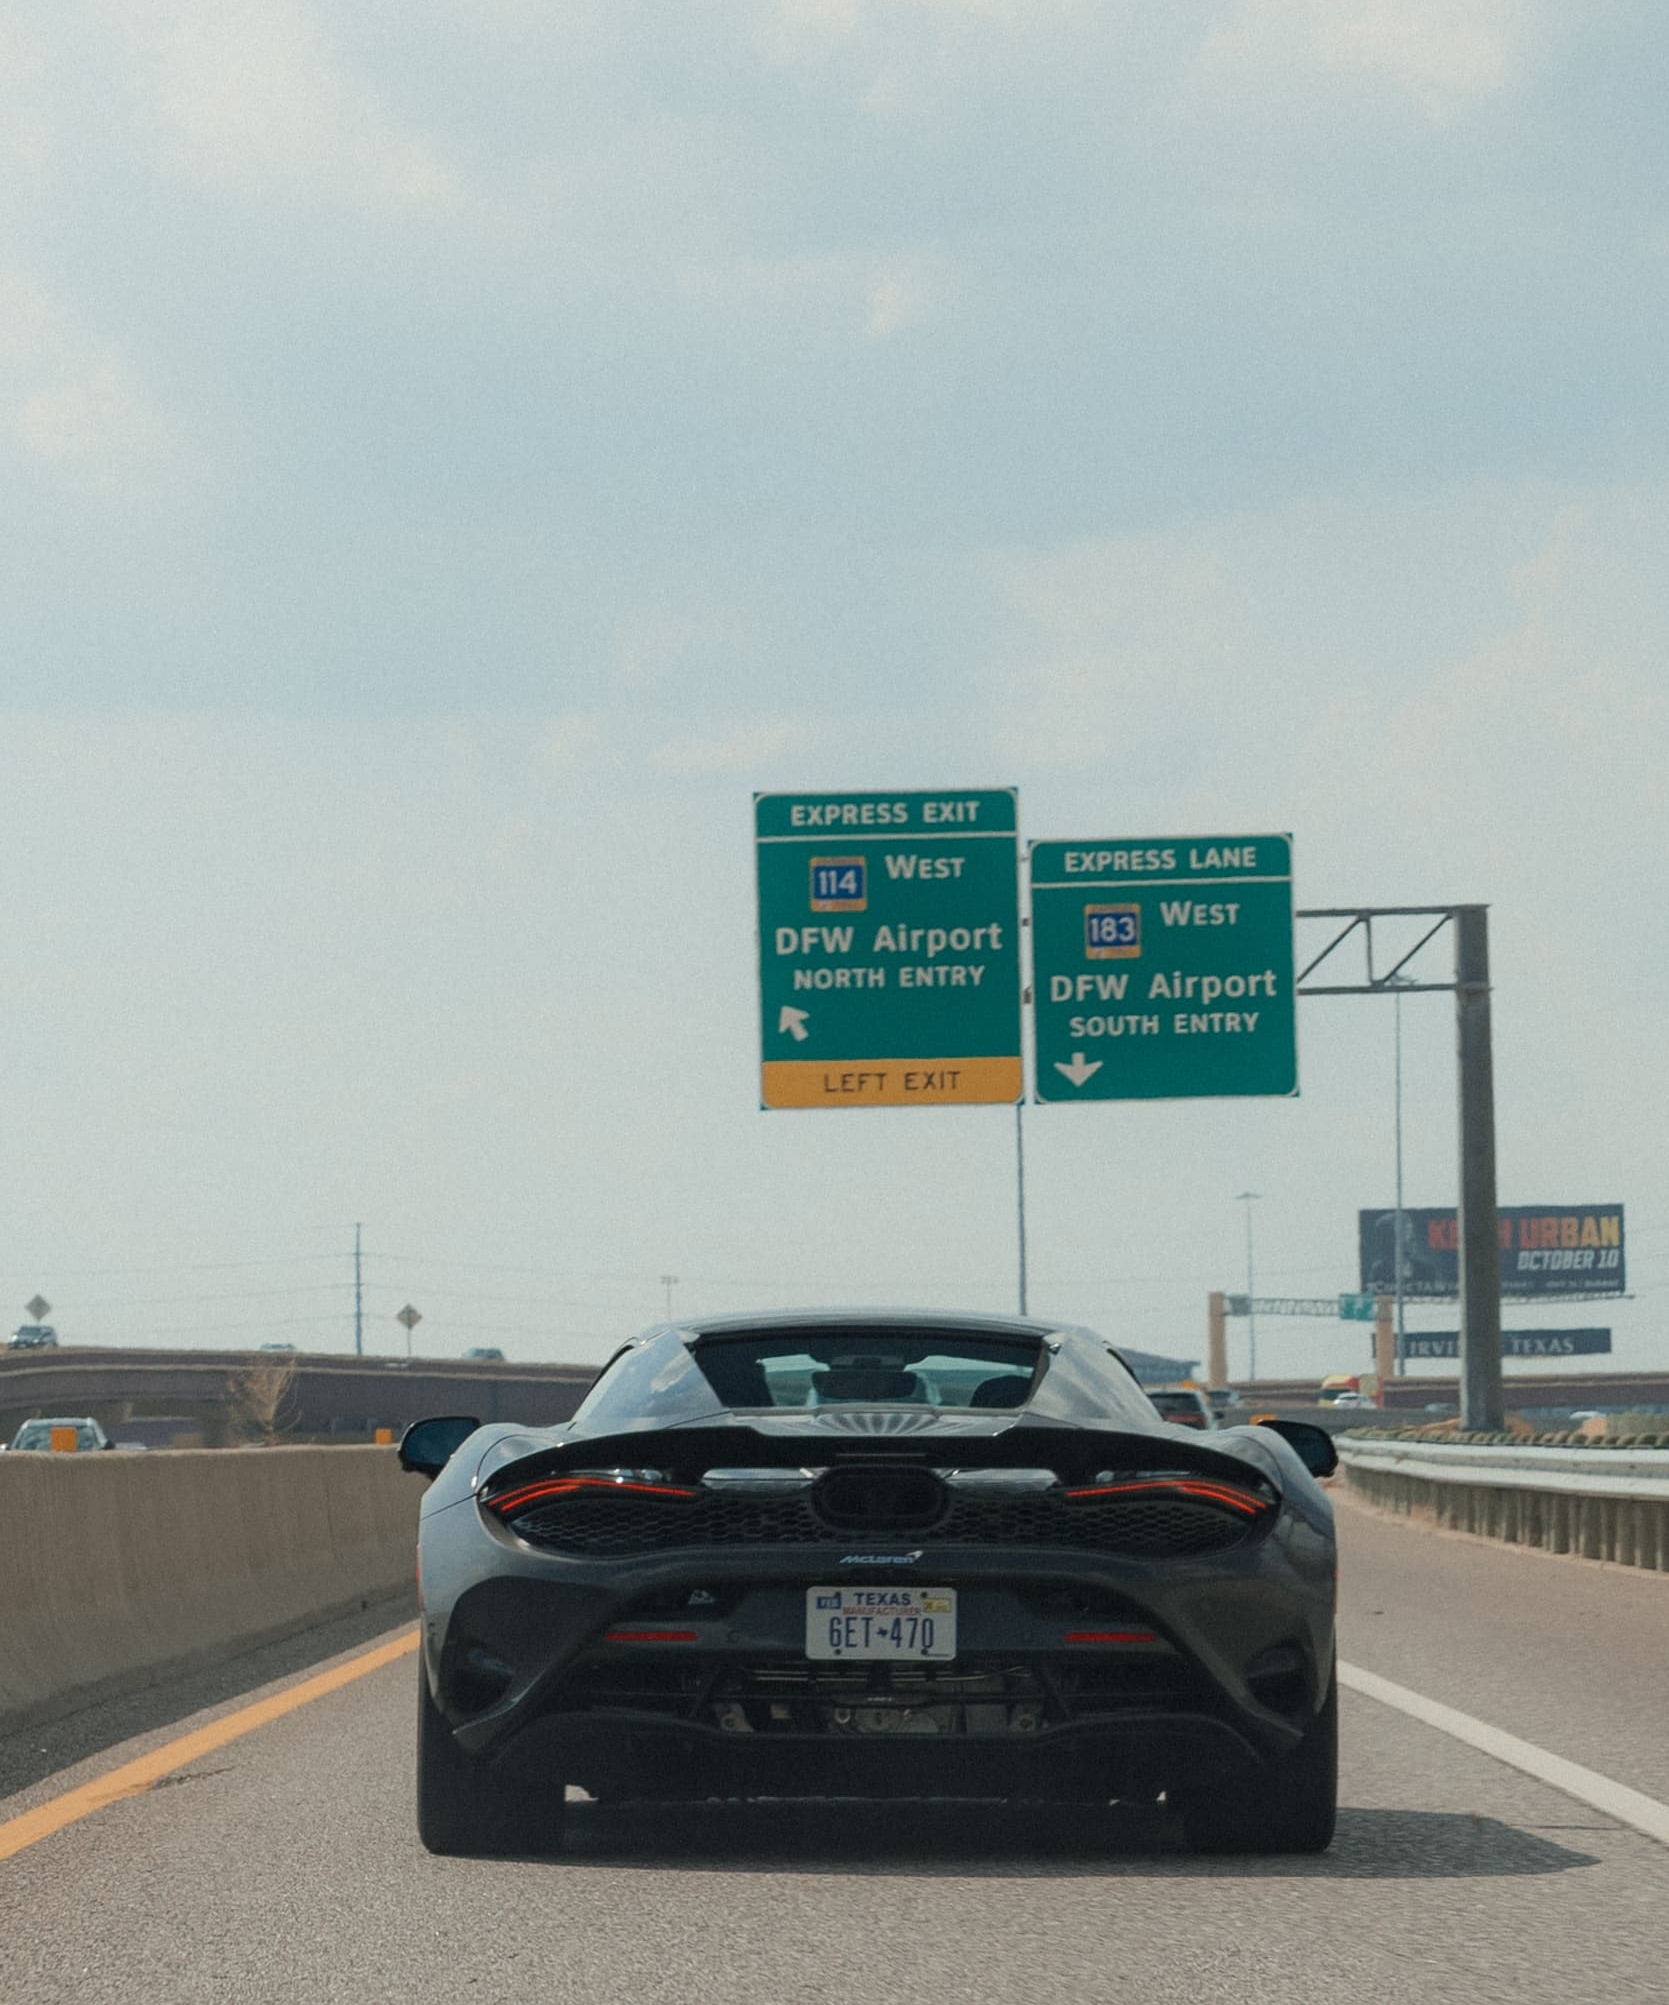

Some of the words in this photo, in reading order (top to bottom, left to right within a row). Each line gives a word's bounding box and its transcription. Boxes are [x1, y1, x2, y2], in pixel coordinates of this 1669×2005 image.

[791, 803, 908, 826] EXPRESS
[923, 801, 980, 824] EXIT
[1064, 849, 1176, 873] EXPRESS
[1190, 847, 1257, 870] LANE
[817, 869, 857, 895] 114
[776, 926, 853, 955] DFW
[873, 922, 1003, 958] Airport
[1089, 917, 1135, 942] 183
[793, 967, 884, 990] NORTH
[899, 965, 985, 989] ENTRY
[1051, 974, 1129, 1002] DFW
[1148, 970, 1277, 1004] Airport
[1070, 1015, 1159, 1038] SOUTH
[1175, 1012, 1260, 1034] ENTRY
[823, 1072, 888, 1093] LEFT
[904, 1071, 961, 1091] EXIT
[1428, 1218, 1512, 1249] KEH
[1520, 1216, 1619, 1248] URBAN
[1518, 1249, 1593, 1270] OCTOBER
[1598, 1249, 1619, 1268] 10
[1410, 1341, 1452, 1355] IRVI
[1512, 1337, 1574, 1353] TEXAS
[840, 1555, 913, 1564] McLaren
[854, 1593, 911, 1605] TEXAS
